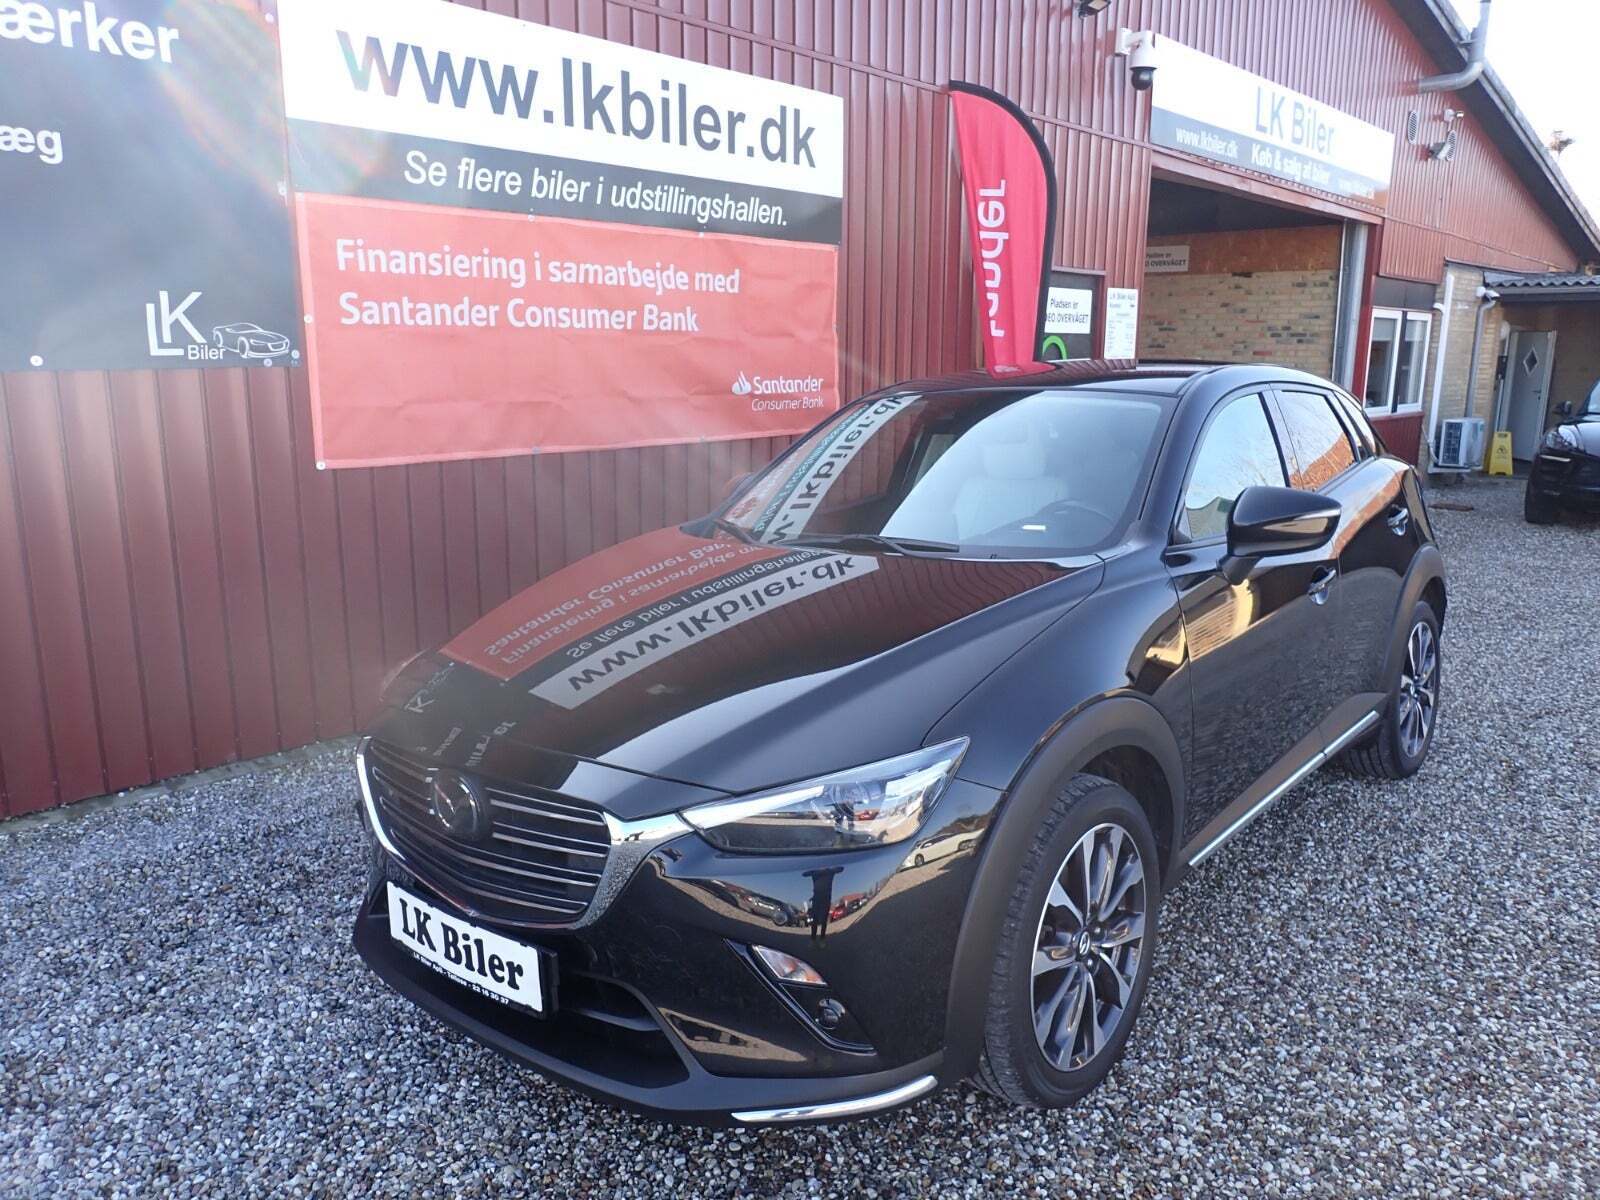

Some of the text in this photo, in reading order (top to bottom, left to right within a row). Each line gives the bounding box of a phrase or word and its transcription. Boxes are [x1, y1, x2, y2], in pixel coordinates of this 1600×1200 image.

[336, 29, 817, 168] www.lkbiler.dk
[1256, 87, 1335, 155] LK Biler
[1176, 128, 1238, 159] www.lkbiler.dk
[1251, 144, 1272, 168] Køb
[1274, 151, 1283, 171] &
[404, 150, 787, 226] Se flere biler i udstillingshallen.
[336, 238, 740, 295] Finansiering i samarbejde med
[339, 292, 699, 331] Santander Consumer Bank
[1050, 297, 1079, 309] Pladsen er
[1057, 312, 1088, 324] OVERVÅGET
[146, 291, 207, 356] LK
[188, 345, 226, 360] Biler
[753, 376, 824, 394] Santander
[751, 396, 824, 411] Consumer Bank
[400, 898, 524, 990] LK Biler
